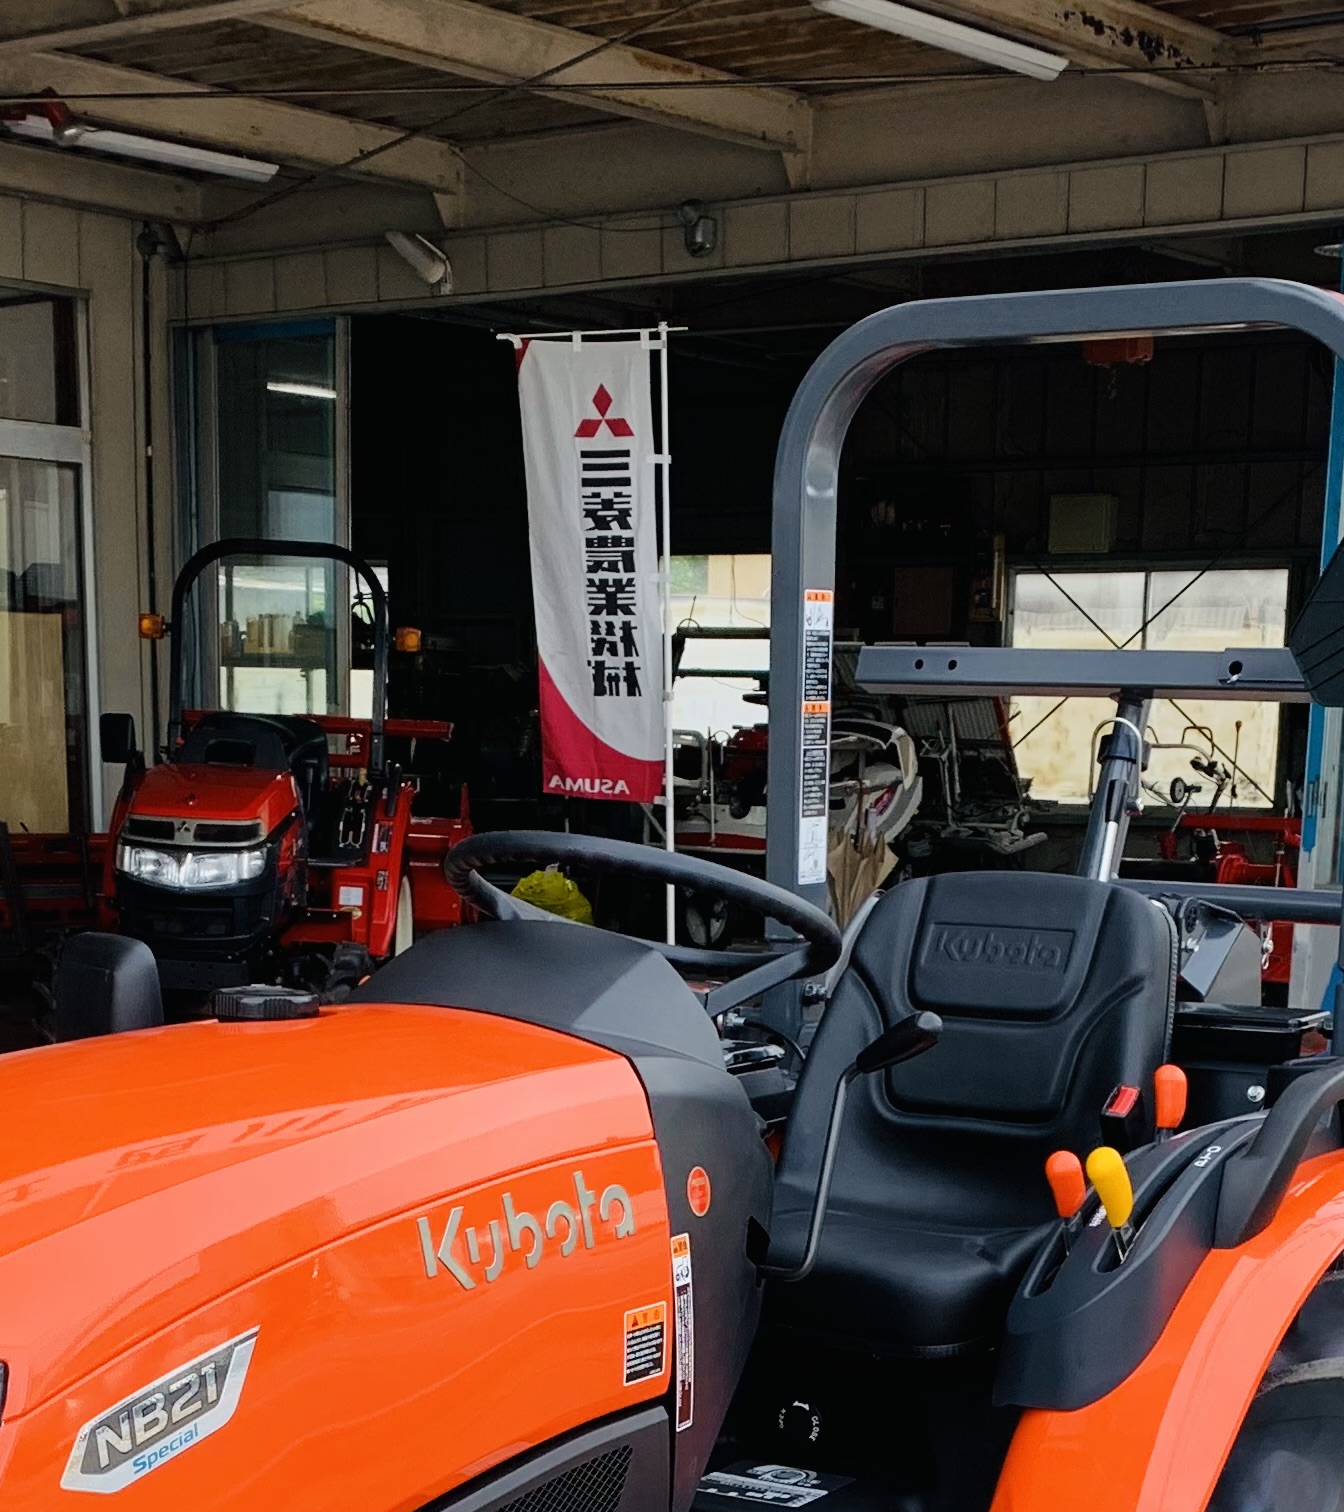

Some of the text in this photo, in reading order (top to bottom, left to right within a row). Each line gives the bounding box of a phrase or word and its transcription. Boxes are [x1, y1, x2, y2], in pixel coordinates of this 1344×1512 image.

[934, 929, 1062, 969] Kubota
[416, 1170, 635, 1290] Kubota
[94, 1358, 220, 1471] NB21
[131, 1422, 200, 1476] Special
